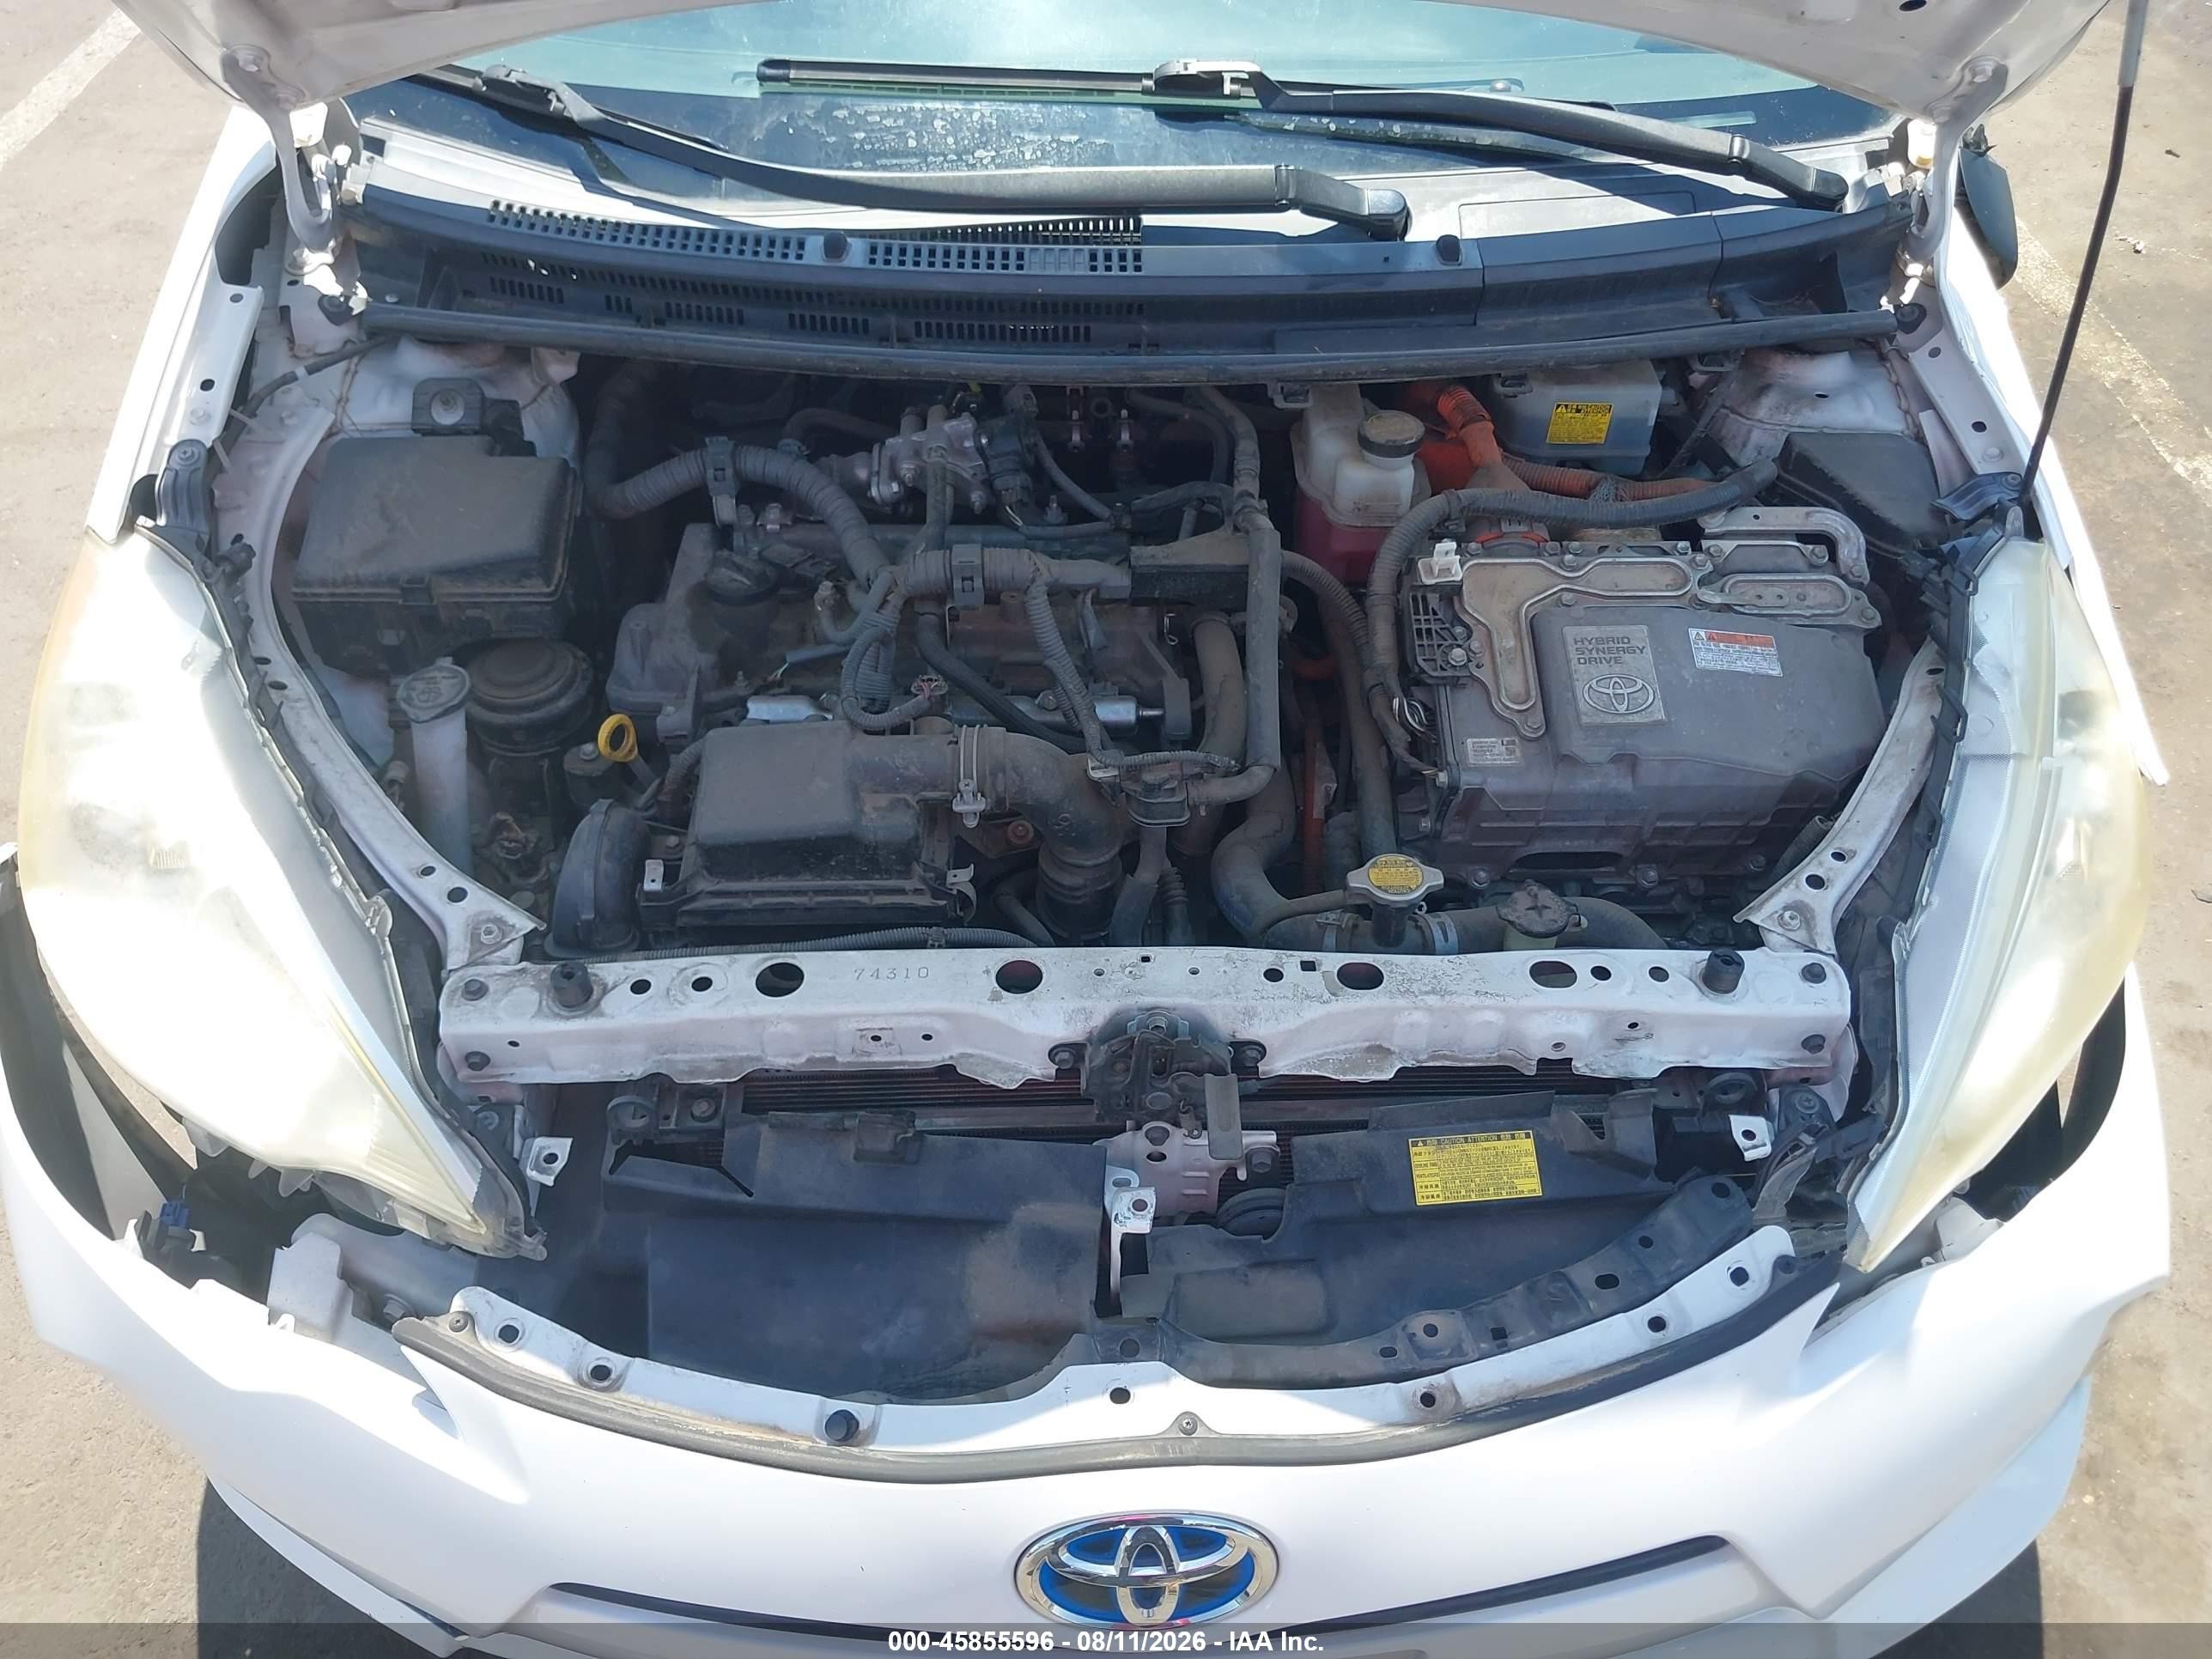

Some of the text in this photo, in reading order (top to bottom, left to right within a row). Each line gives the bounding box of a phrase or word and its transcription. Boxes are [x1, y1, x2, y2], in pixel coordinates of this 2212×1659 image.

[1574, 636, 1631, 645] HYBRID
[1575, 646, 1646, 655] SYNERGY
[1577, 656, 1623, 665] DRIVE
[854, 966, 929, 980] 74310
[1468, 1134, 1498, 1143] ATTENTION
